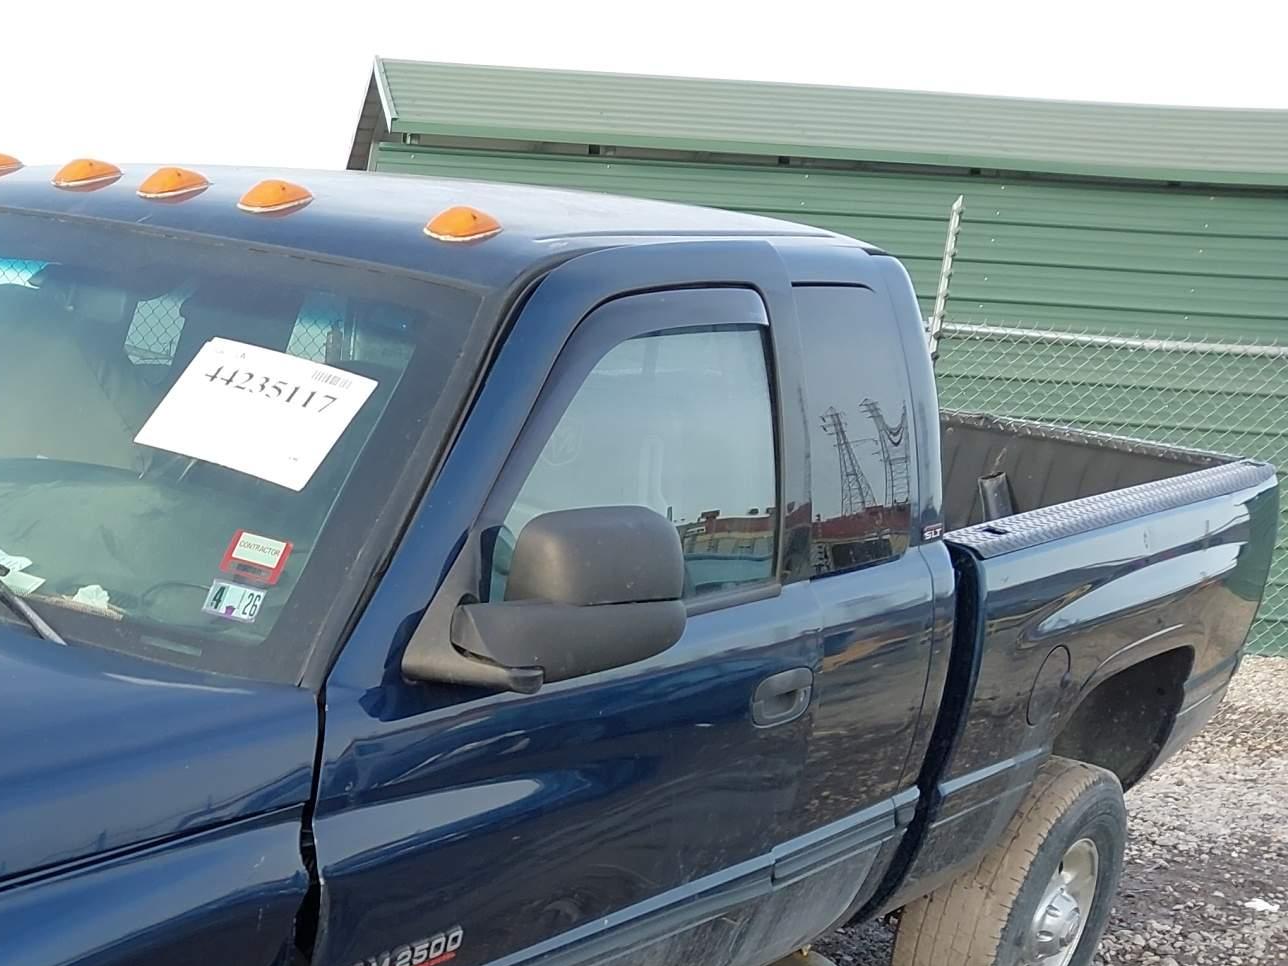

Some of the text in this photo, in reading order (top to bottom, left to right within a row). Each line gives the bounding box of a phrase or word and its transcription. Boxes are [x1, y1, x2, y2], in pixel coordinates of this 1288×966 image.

[205, 366, 337, 413] 44235117
[923, 527, 942, 540] SLT
[238, 540, 281, 557] CONTRACTOR
[210, 586, 261, 617] 4 26
